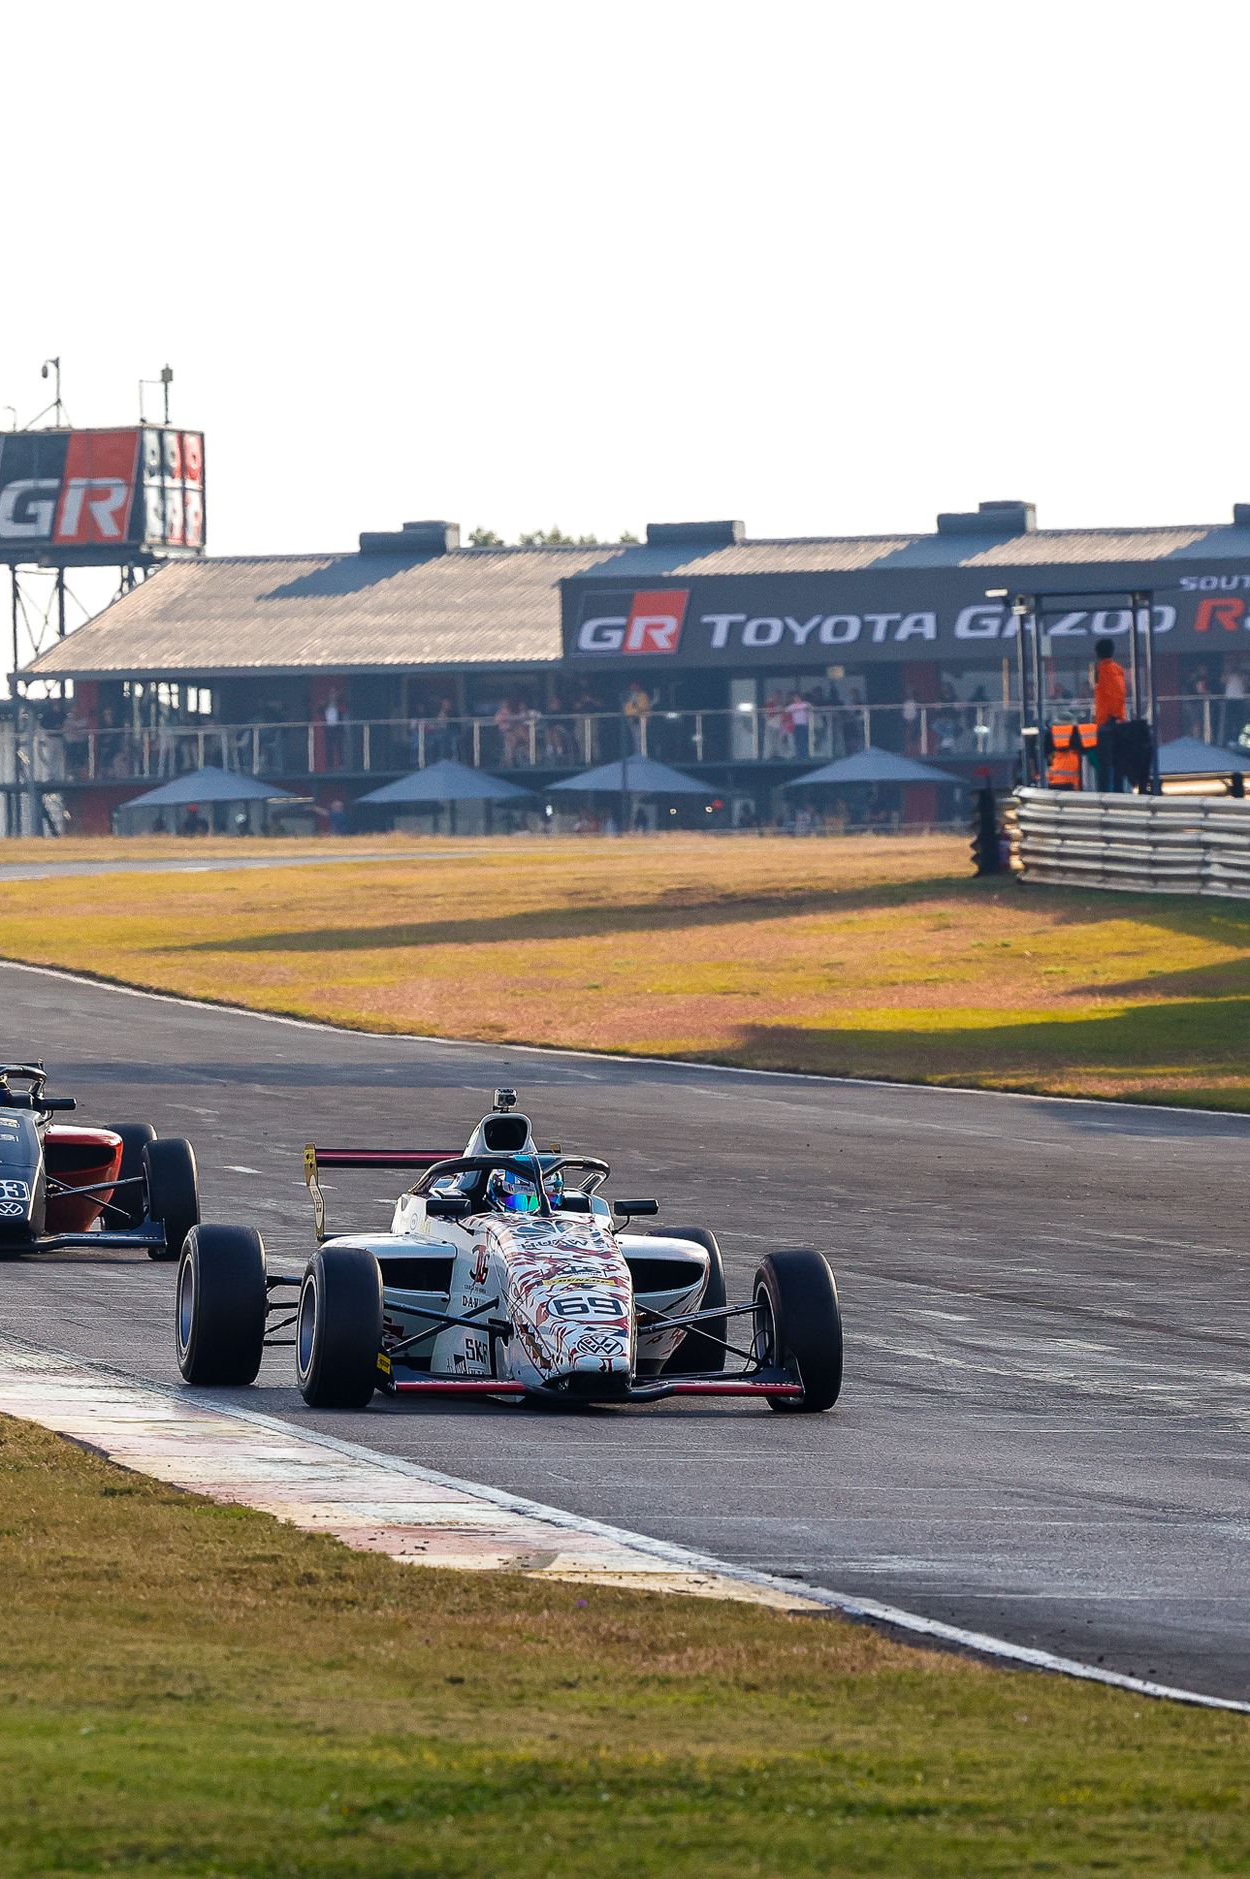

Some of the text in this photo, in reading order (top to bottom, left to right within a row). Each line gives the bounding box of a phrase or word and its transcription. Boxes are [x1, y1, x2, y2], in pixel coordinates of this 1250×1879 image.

[577, 615, 679, 651] GR
[700, 612, 938, 648] TOYOTA
[1195, 597, 1250, 632] R
[553, 1297, 624, 1316] 69
